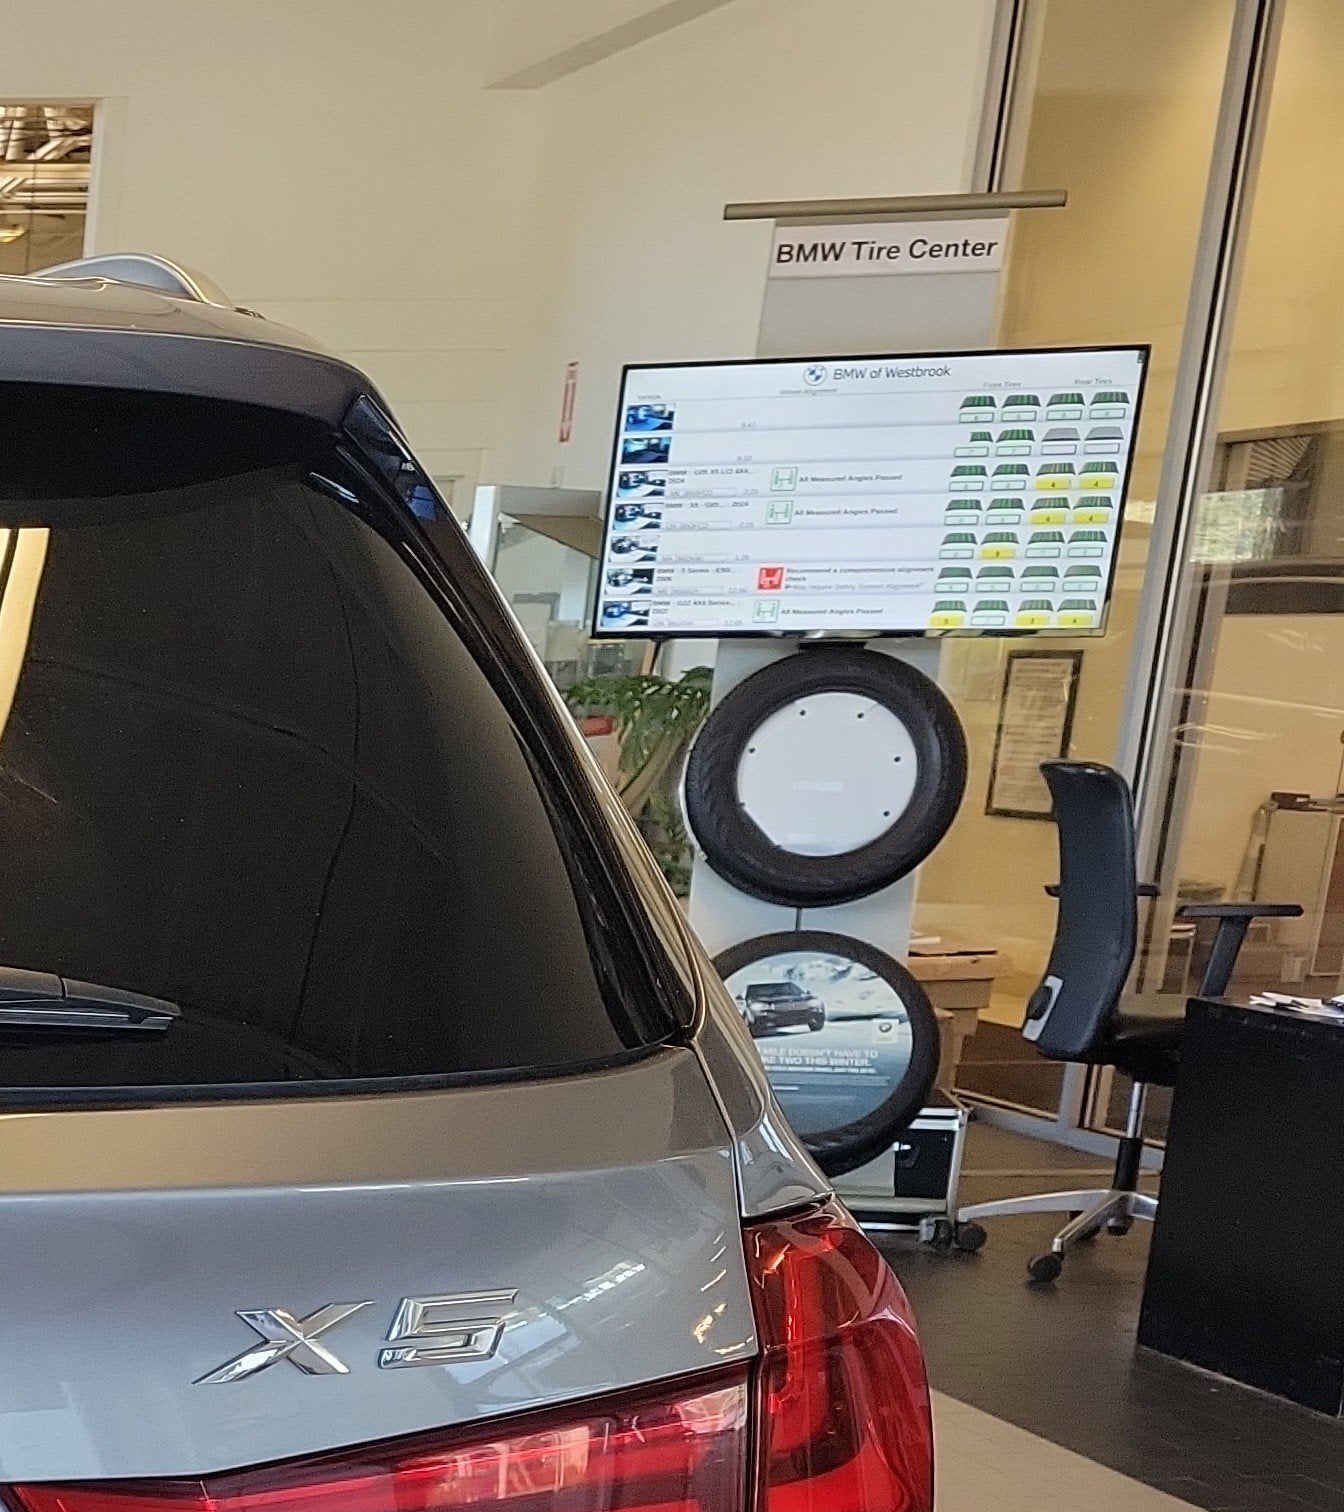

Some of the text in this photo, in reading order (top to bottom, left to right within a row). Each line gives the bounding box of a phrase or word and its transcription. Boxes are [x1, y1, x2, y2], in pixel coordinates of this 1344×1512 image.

[776, 238, 998, 264] BMW Tire Center
[833, 365, 952, 380] BMW of Westbrook
[192, 1287, 520, 1385] X5
